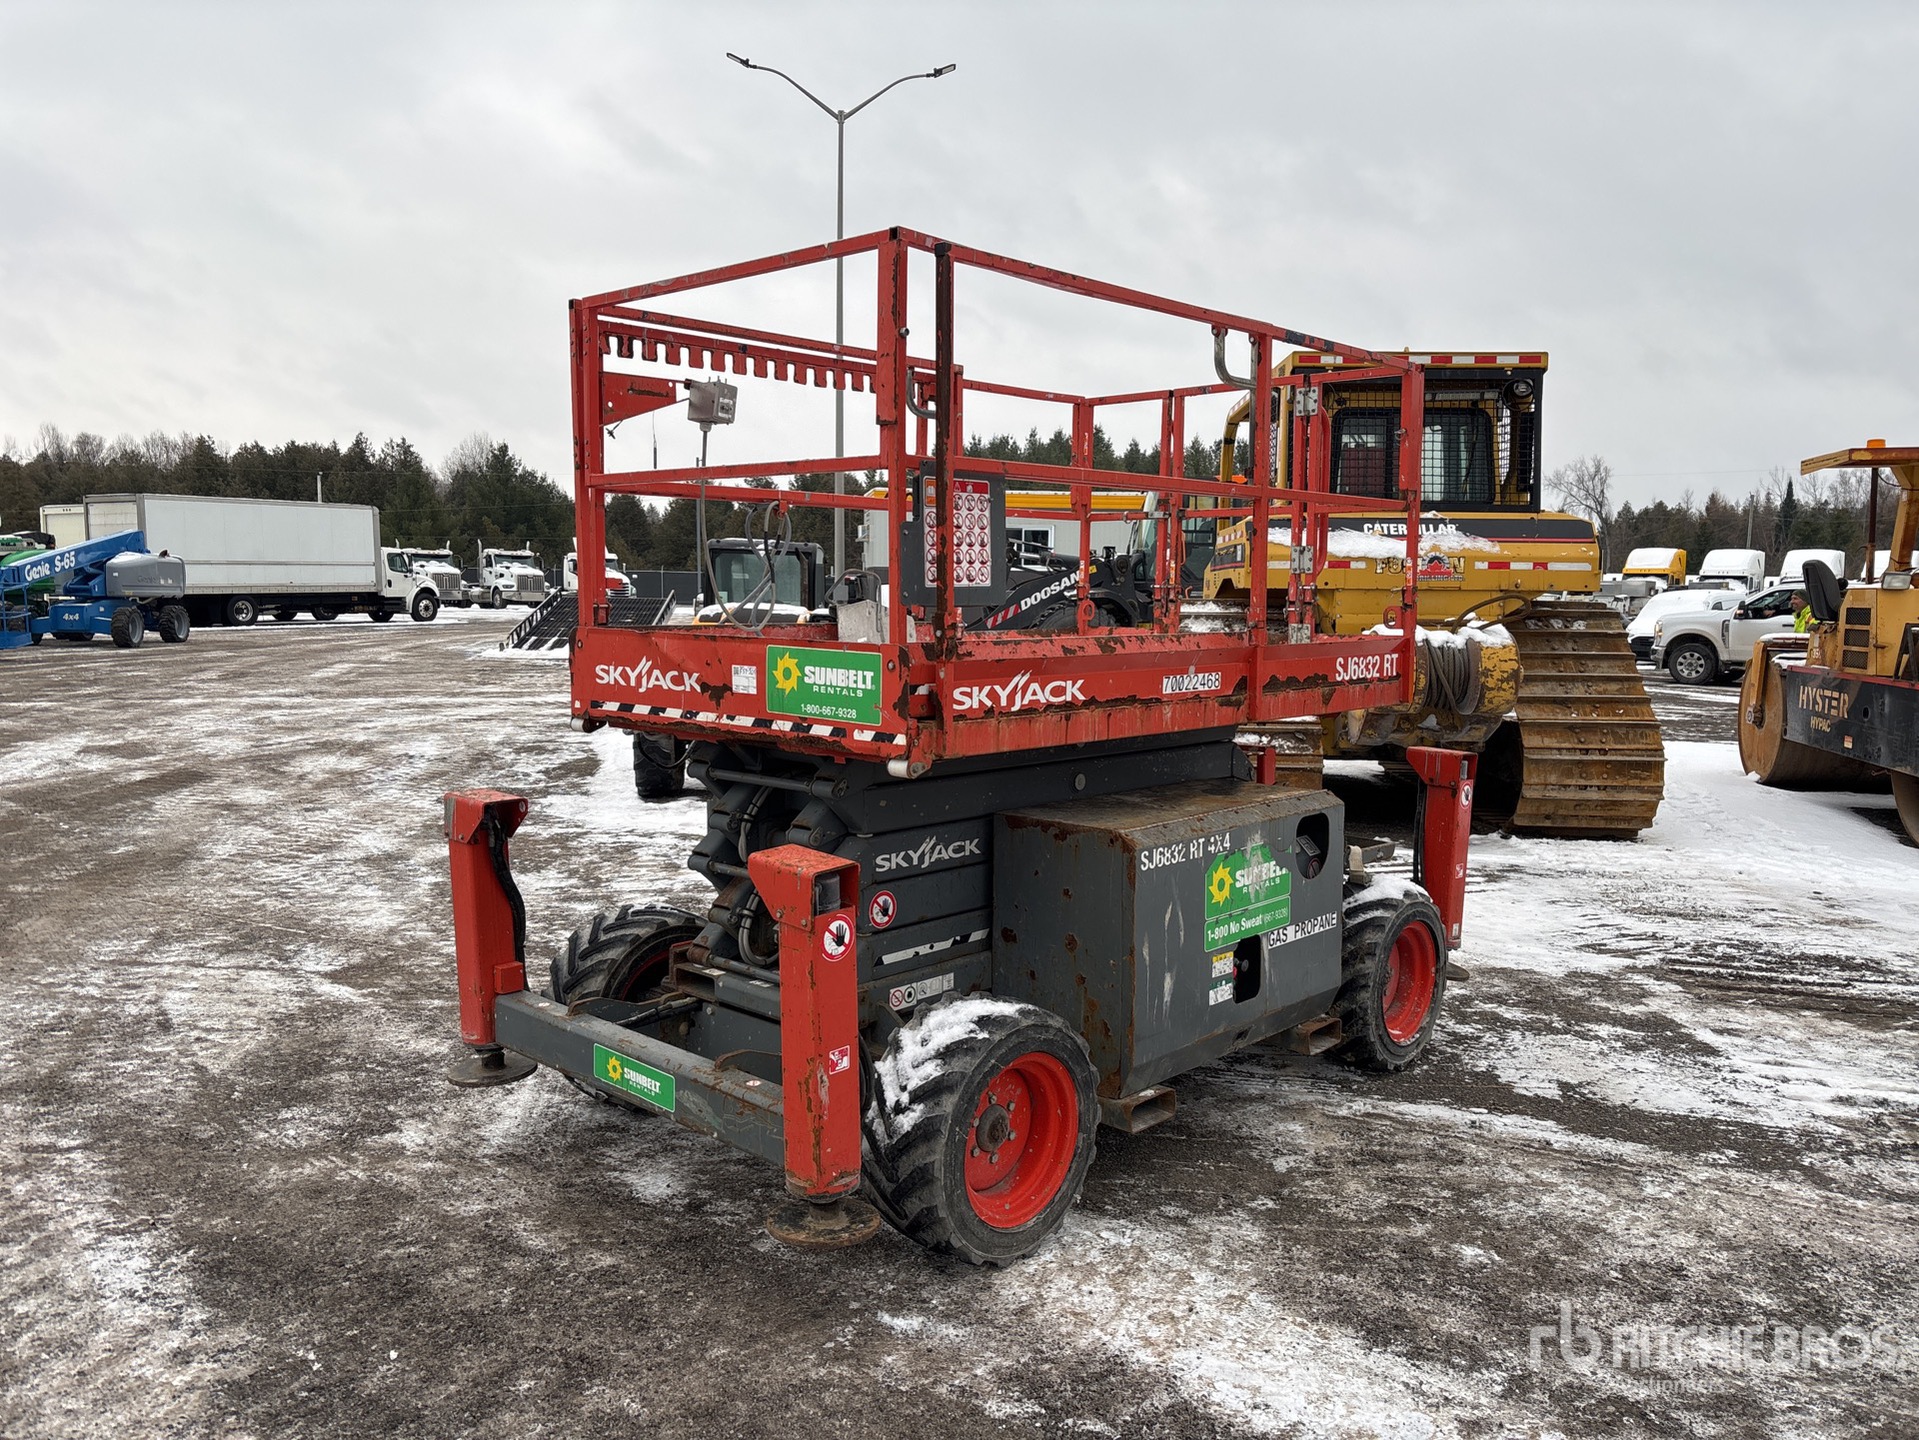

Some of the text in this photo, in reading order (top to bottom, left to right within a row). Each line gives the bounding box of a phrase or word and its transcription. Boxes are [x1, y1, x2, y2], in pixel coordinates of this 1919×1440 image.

[1363, 523, 1458, 536] CATERILLAR
[25, 551, 76, 581] Genie S-65
[1021, 570, 1080, 611] DOOSAN
[62, 613, 80, 621] 4x4
[595, 656, 701, 693] SKYJACK
[804, 666, 874, 689] SUNBELT
[1336, 654, 1398, 681] SJ6832 RT
[813, 685, 863, 697] RENTALS
[953, 670, 1086, 711] SKYJACK
[1164, 673, 1220, 692] 70022468
[801, 704, 857, 718] 1-800-667-9328
[1799, 685, 1849, 718] HYSTER
[1810, 716, 1831, 733] HYPAC
[875, 835, 981, 872] SKYJACK
[1140, 843, 1186, 871] SJ6832
[1190, 838, 1204, 859] RT
[1207, 924, 1228, 941] 1-800
[1230, 921, 1240, 934] No
[1241, 914, 1262, 930] Sweat
[1268, 912, 1336, 946] GAS PROPANE
[624, 1067, 660, 1093] SUNBELT
[629, 1081, 655, 1096] RENTALS
